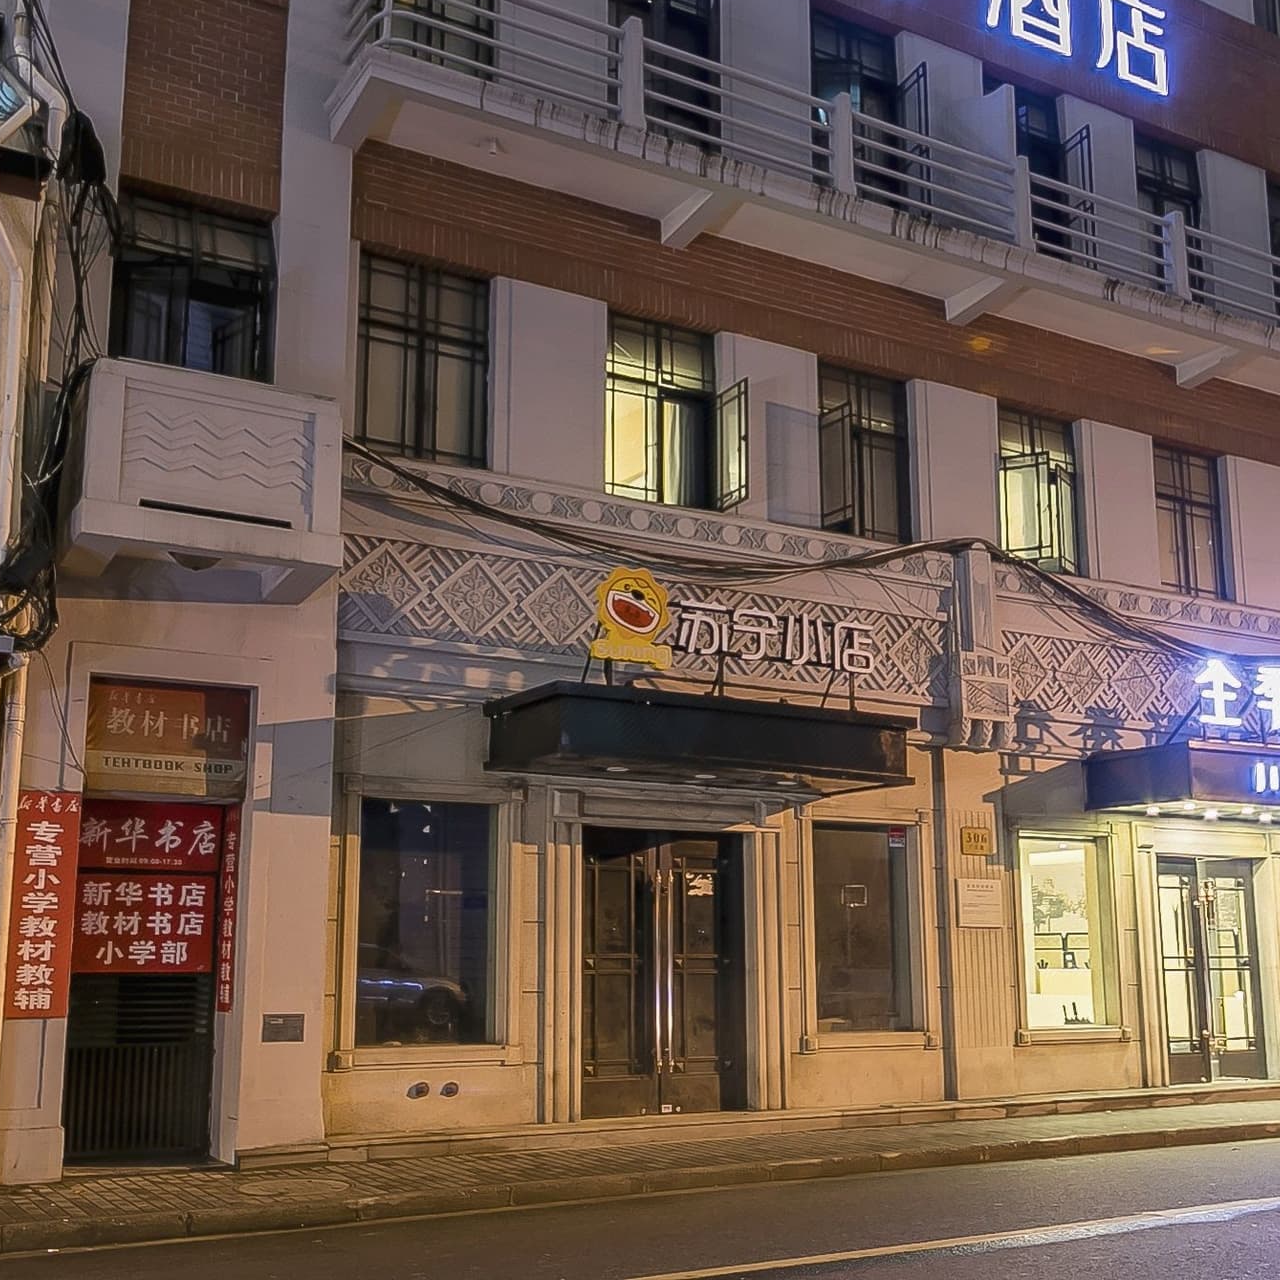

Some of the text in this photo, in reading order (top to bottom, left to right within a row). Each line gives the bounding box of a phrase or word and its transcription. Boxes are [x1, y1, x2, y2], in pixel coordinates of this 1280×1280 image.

[679, 598, 874, 674] 苏宁小店
[106, 706, 232, 744] 教材书店
[193, 762, 233, 775] SHOP
[78, 817, 216, 856] 新华书店
[82, 881, 206, 907] 新华书店
[14, 820, 65, 1010] 专营小学教材教辅
[81, 910, 204, 936] 教材书店
[96, 940, 188, 965] 小学部
